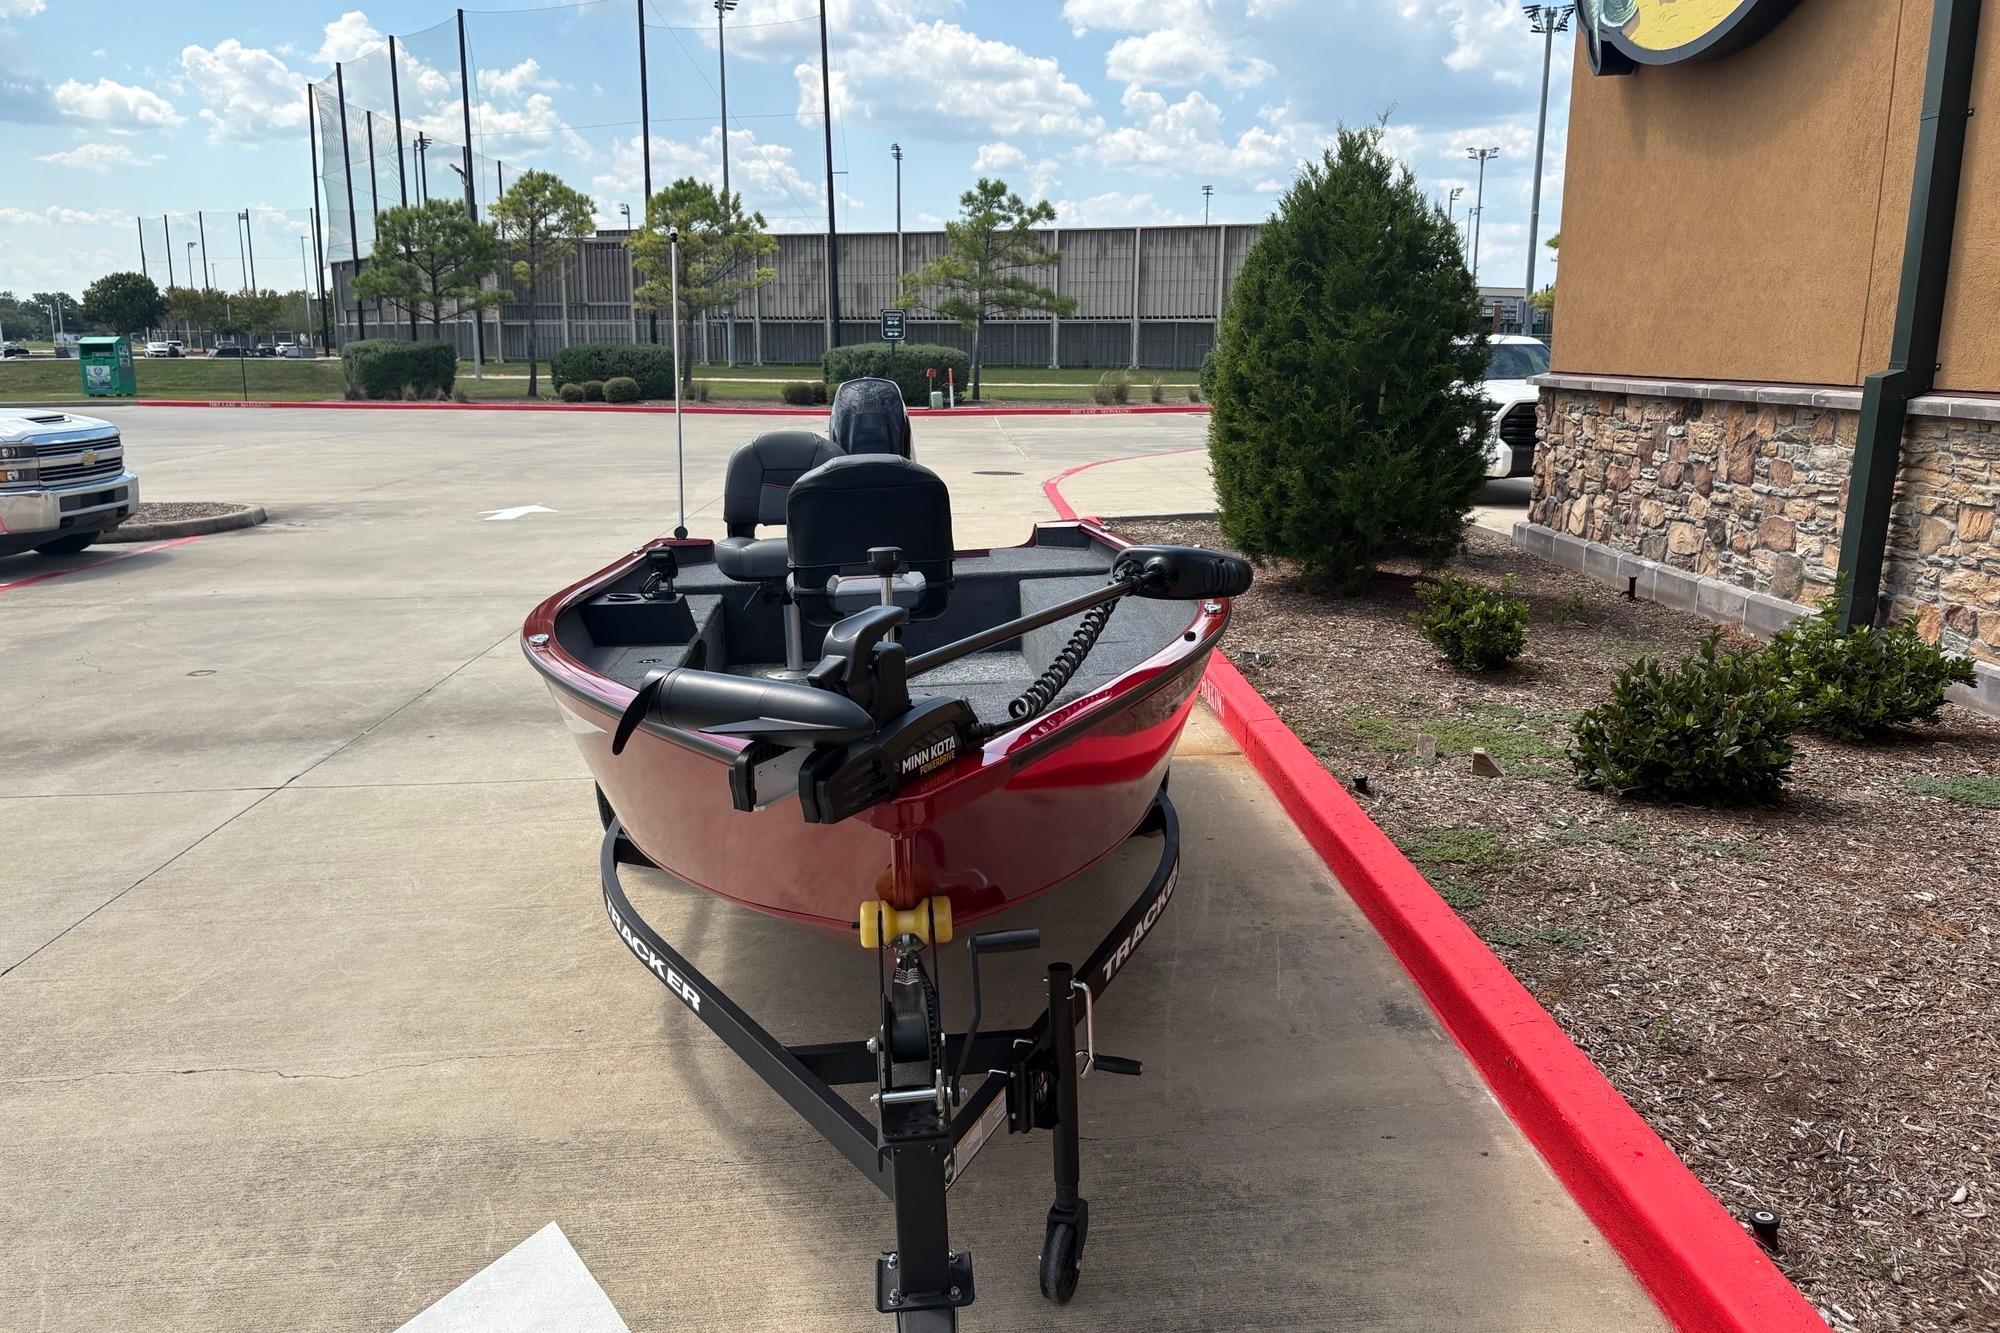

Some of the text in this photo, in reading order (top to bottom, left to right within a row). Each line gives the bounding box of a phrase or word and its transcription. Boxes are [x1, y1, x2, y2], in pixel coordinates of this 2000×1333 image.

[902, 736, 955, 774] MINN KOTA
[920, 750, 955, 775] POWERDRIVE
